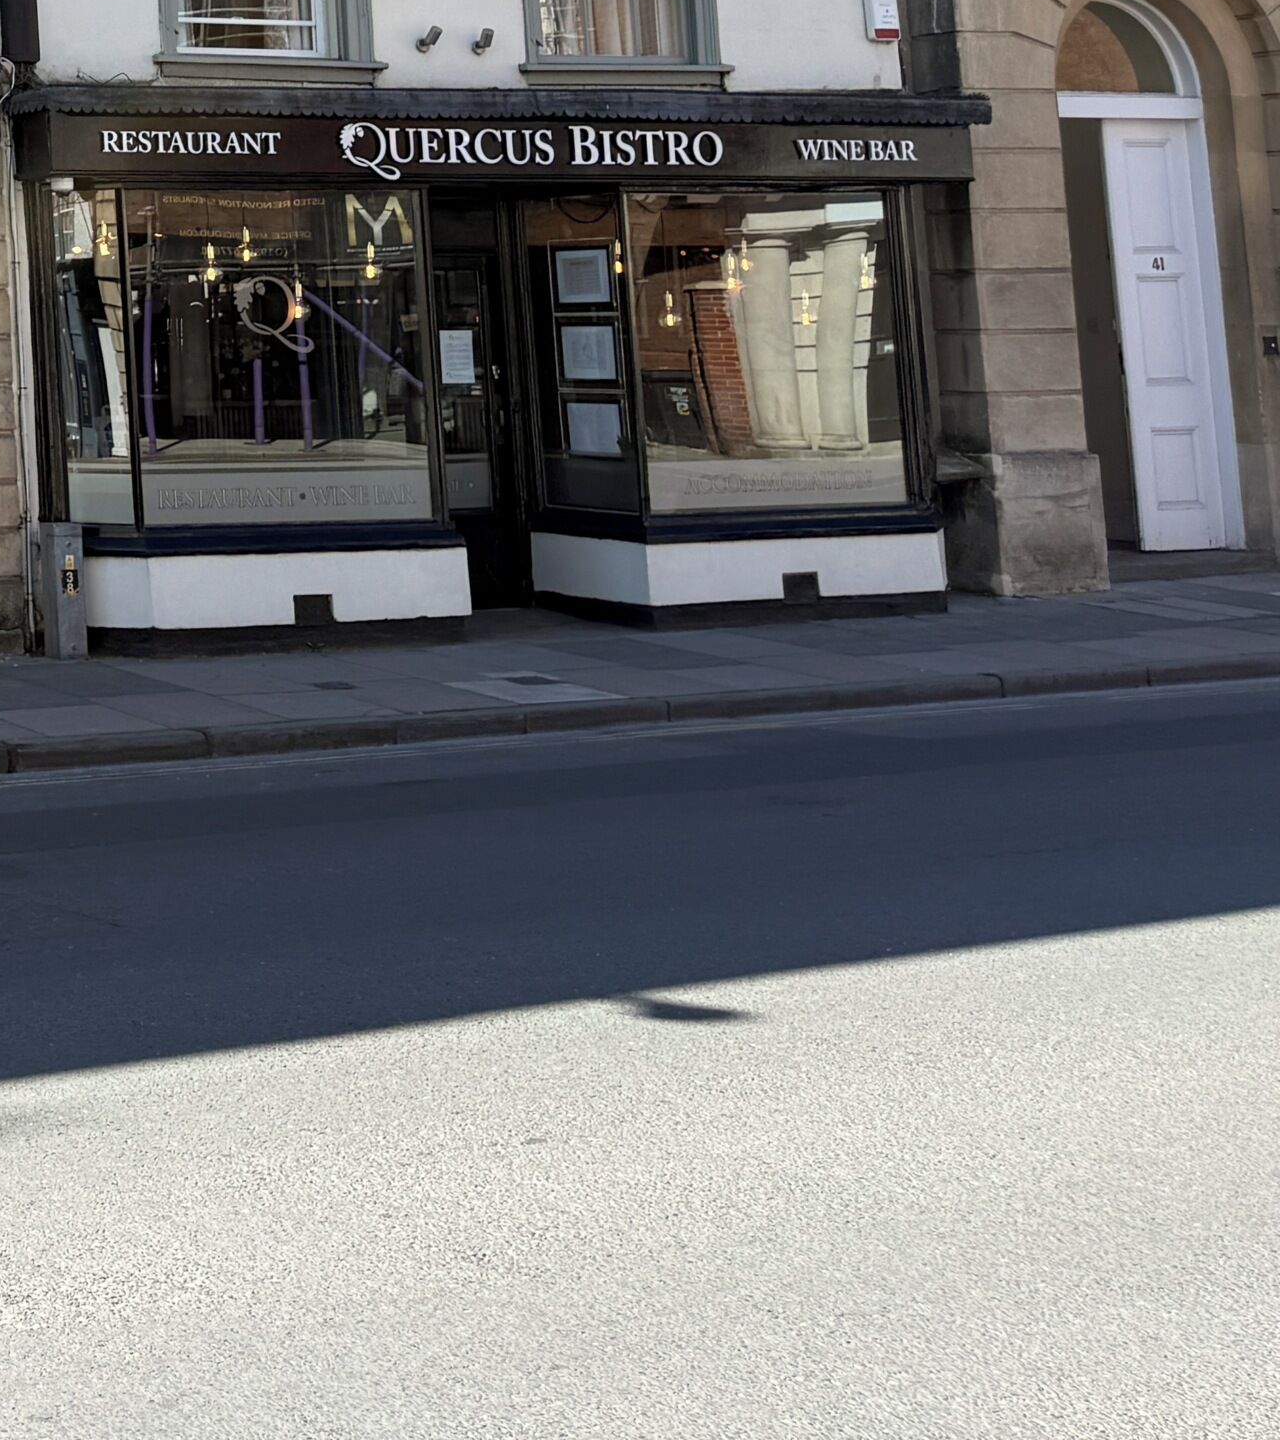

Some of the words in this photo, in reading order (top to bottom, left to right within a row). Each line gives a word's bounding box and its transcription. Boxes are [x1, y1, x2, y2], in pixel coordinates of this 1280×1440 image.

[102, 130, 281, 155] RESTAURANT
[340, 122, 555, 180] QUERCUS
[568, 125, 723, 166] BISTRO
[796, 139, 865, 161] WINE
[869, 140, 918, 161] BAR
[1152, 257, 1165, 271] 41
[157, 486, 295, 509] RESTAURANT
[310, 485, 370, 506] WINE
